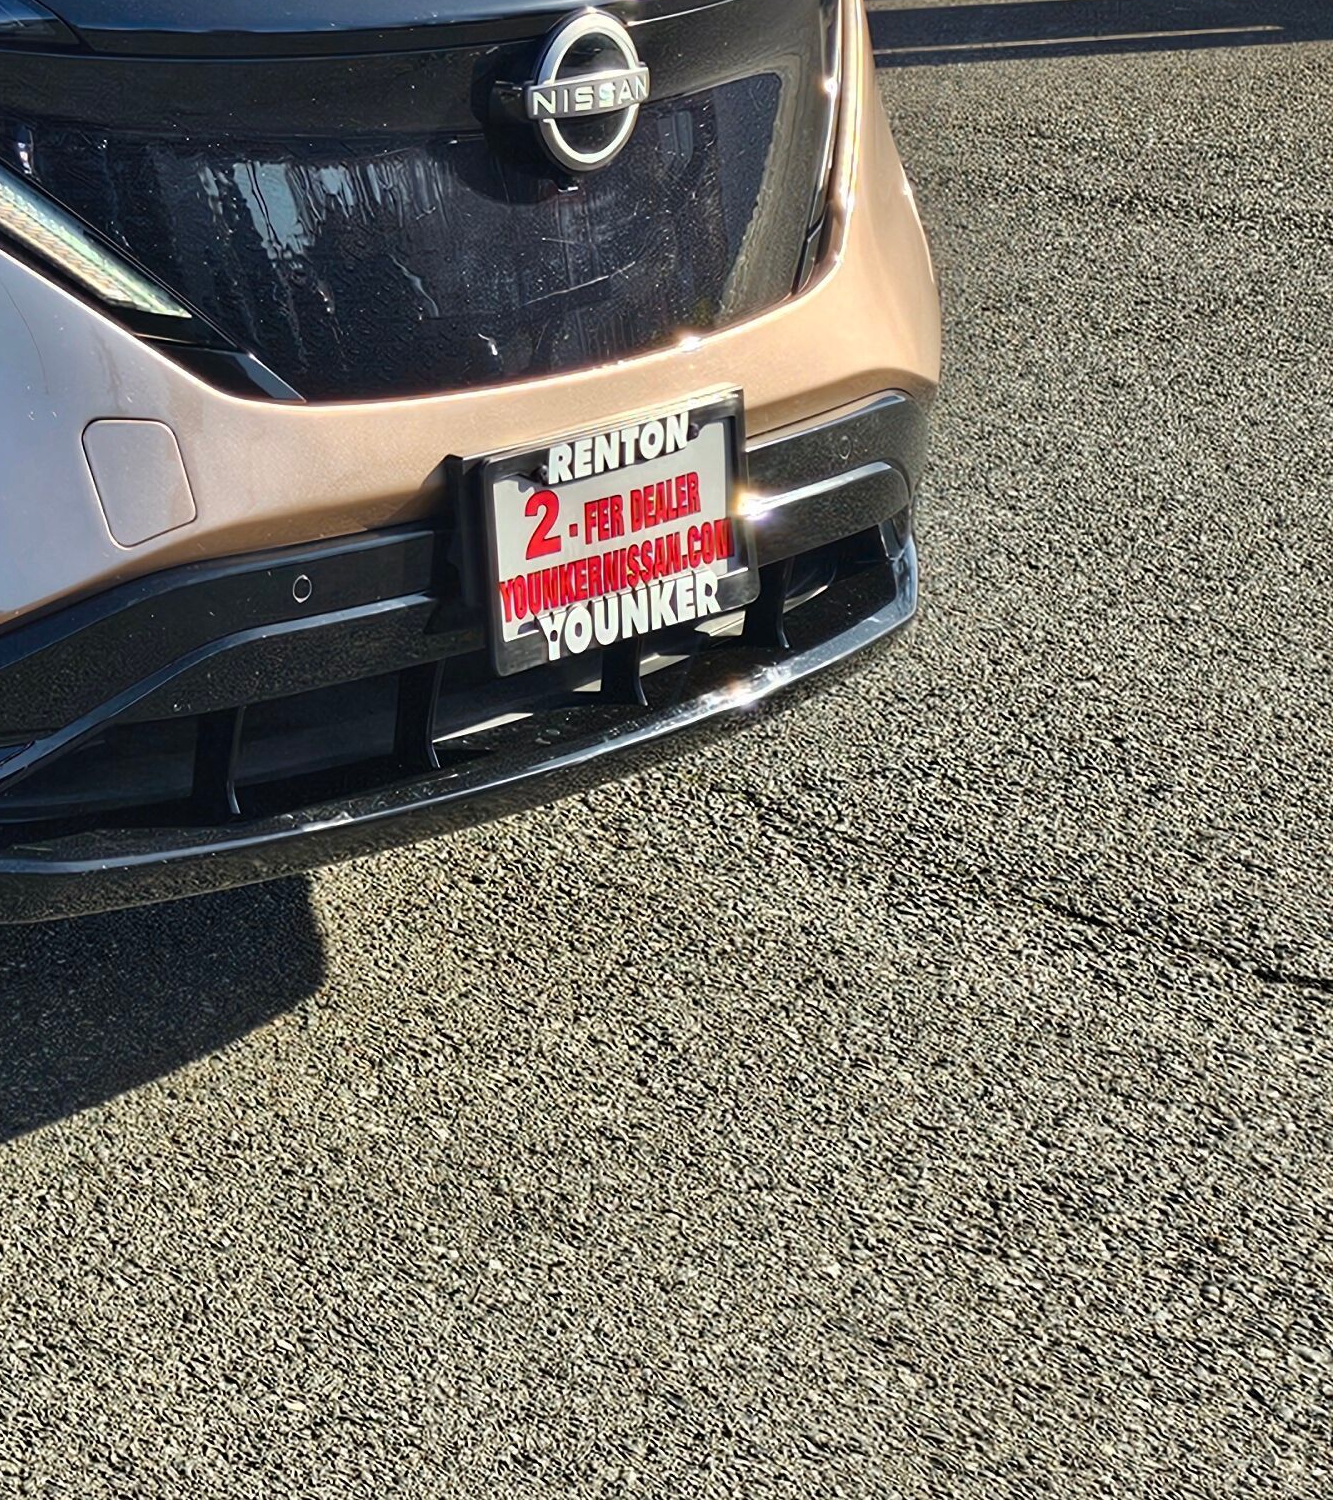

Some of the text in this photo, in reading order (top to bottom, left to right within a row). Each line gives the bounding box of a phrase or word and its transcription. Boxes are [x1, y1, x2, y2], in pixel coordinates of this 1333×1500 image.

[532, 72, 649, 116] NISSAN
[548, 412, 689, 485] RENTON
[584, 493, 625, 546] FER
[630, 470, 701, 533] DEALER
[499, 517, 735, 623] YOUNKERNISSAN.COM
[536, 569, 722, 662] YOUNKER
